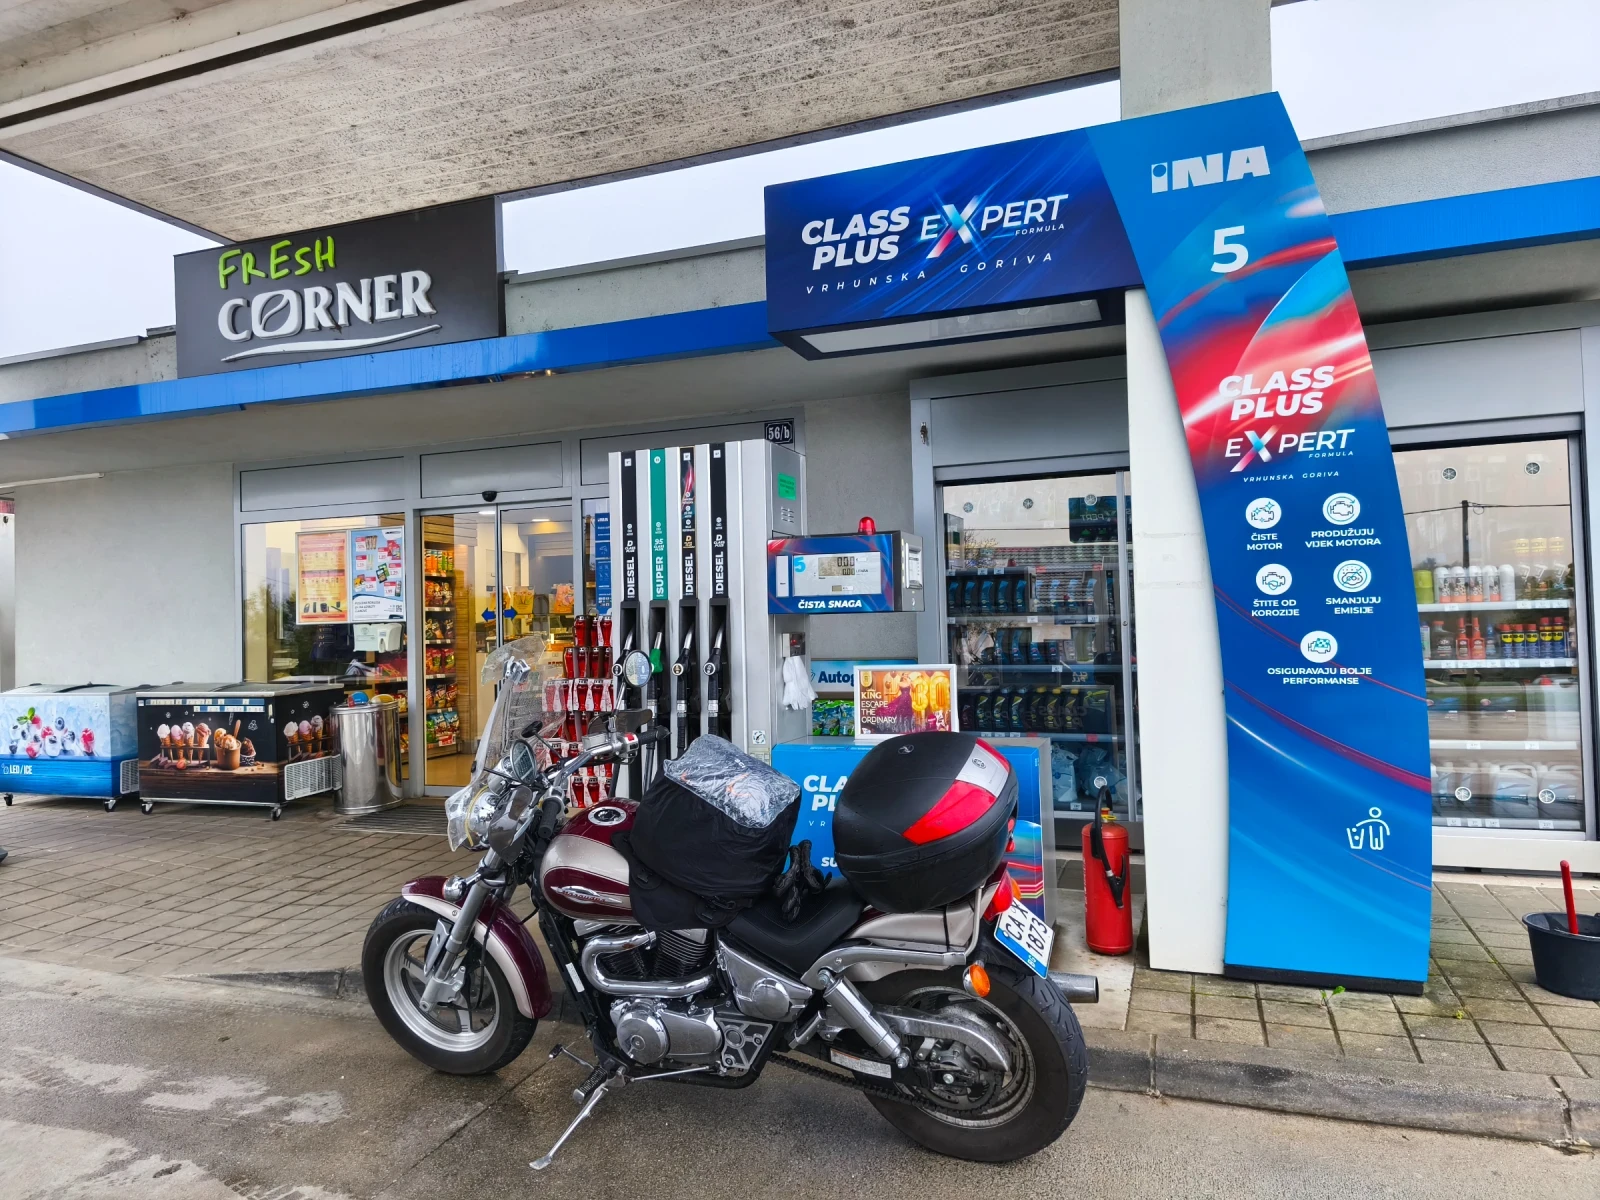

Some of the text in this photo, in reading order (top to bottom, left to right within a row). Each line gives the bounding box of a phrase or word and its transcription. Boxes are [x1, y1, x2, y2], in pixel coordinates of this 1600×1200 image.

[1151, 146, 1270, 194] INA
[801, 194, 1069, 259] CLASS EXPERT
[812, 223, 1066, 271] PLUS FORMULA
[1210, 226, 1249, 274] 5
[218, 236, 336, 289] FRESH
[806, 252, 1053, 295] VRHUNSKA GORIVA
[218, 269, 437, 342] CORNER
[1218, 365, 1335, 397] CLASS
[1230, 391, 1324, 421] PLUS
[768, 425, 790, 440] 56/b
[1225, 424, 1355, 473] EXPERT
[1308, 451, 1354, 459] FORMULA
[1243, 471, 1339, 483] VRHUNSKA GORIVA
[1251, 532, 1278, 541] ČISTE
[1311, 528, 1374, 538] PRODUŽUJU
[1247, 542, 1282, 550] MOTOR
[1305, 538, 1381, 548] VIJEK MOTORA
[716, 552, 724, 592] DIESEL
[794, 556, 806, 572] 5
[627, 556, 635, 596] DIESEL
[656, 556, 664, 595] SUPER
[685, 553, 693, 593] DIESEL
[798, 599, 862, 609] ČISTA SNAGA
[1253, 599, 1279, 607] ŠTITE
[1326, 597, 1381, 605] SMANJUJU
[1251, 609, 1300, 617] KOROZIJE
[1340, 667, 1372, 675] BOLJE
[1283, 677, 1359, 685] PERFORMANSE
[861, 691, 882, 699] KING
[861, 716, 897, 724] ORDINARY
[1026, 917, 1048, 957] 1873
